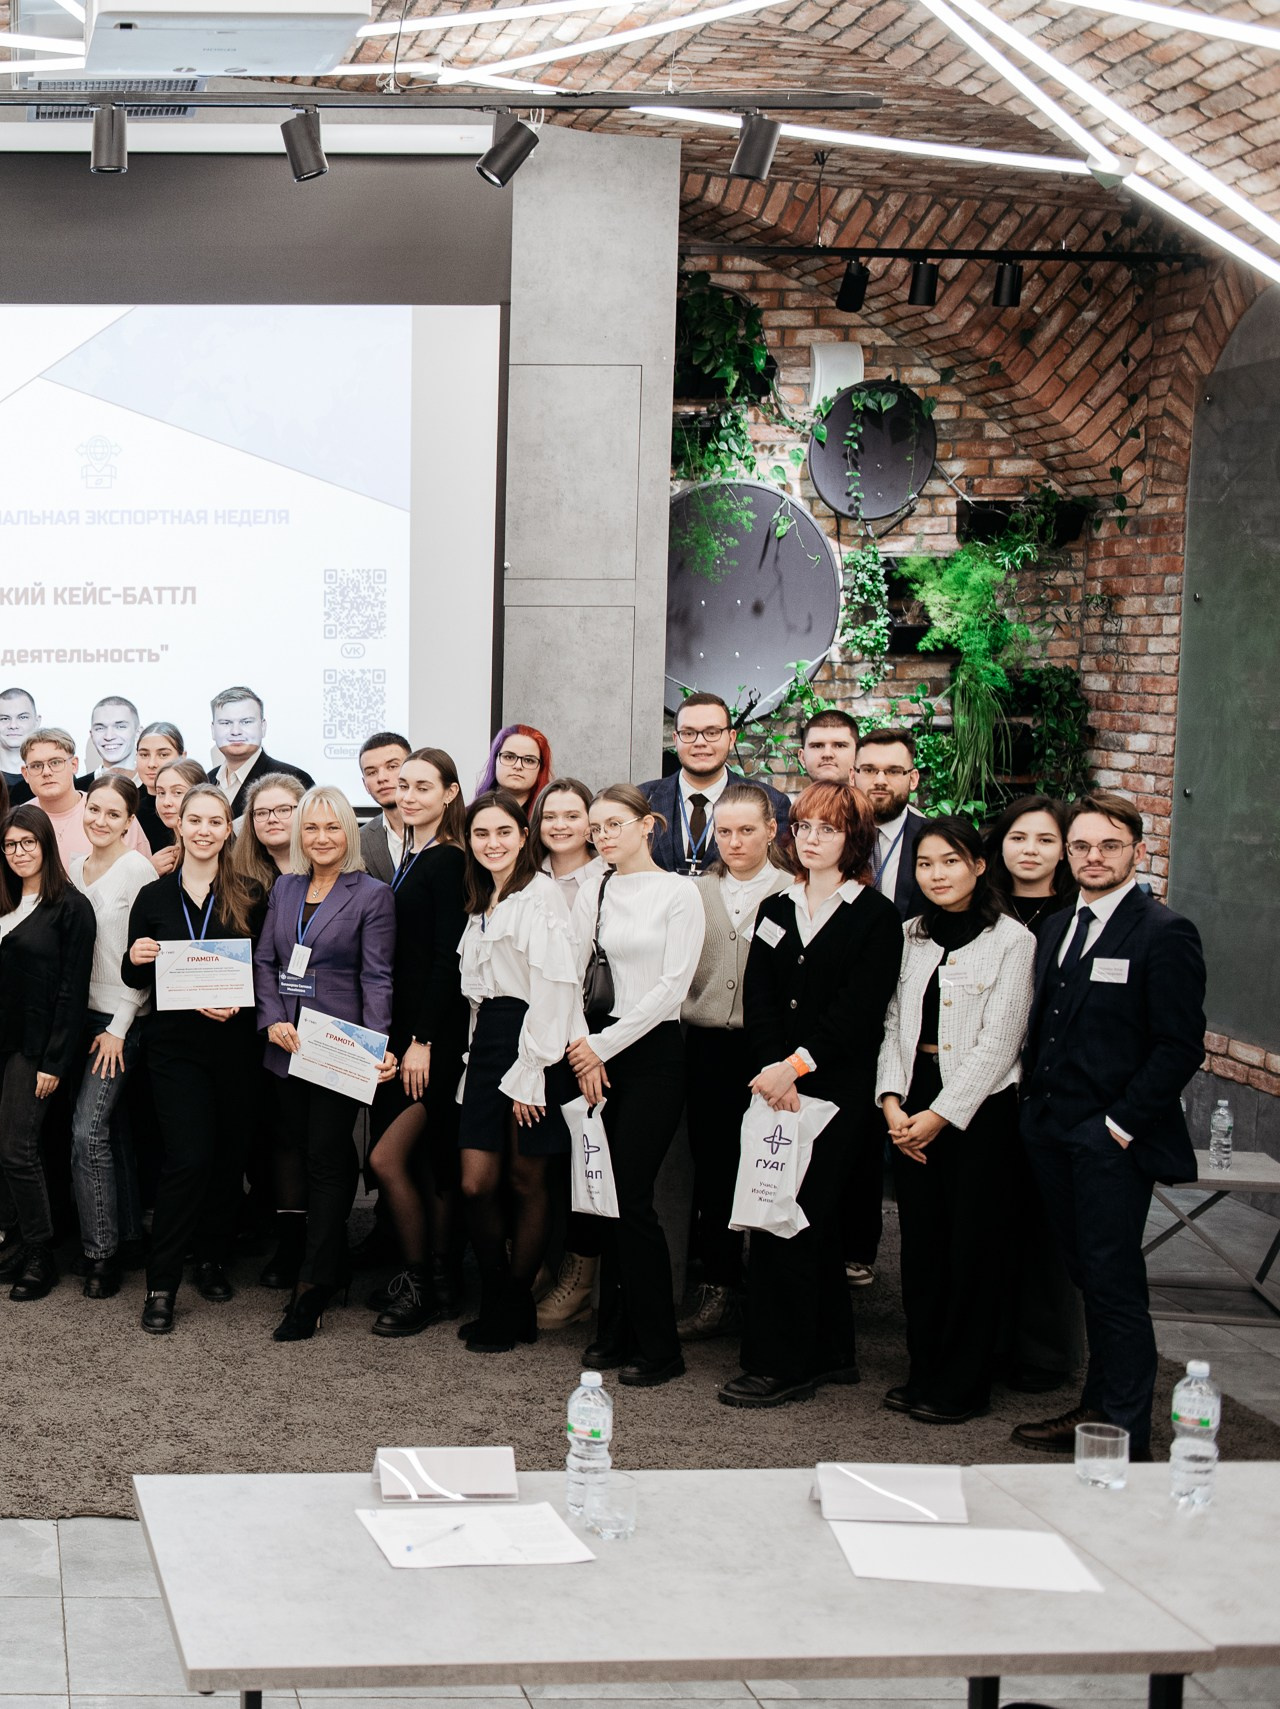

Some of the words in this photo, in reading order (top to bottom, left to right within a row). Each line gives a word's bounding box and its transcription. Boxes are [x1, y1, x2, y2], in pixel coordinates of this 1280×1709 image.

[84, 508, 209, 526] ЭКСПОРТНАЯ
[213, 508, 290, 528] НЕДЕЛЯ
[53, 581, 197, 606] КЕЙС-БАТТЛ
[0, 643, 169, 667] деятельность"
[344, 646, 361, 656] VK
[327, 747, 358, 757] Telegr
[325, 1032, 356, 1048] ГРАМОТА
